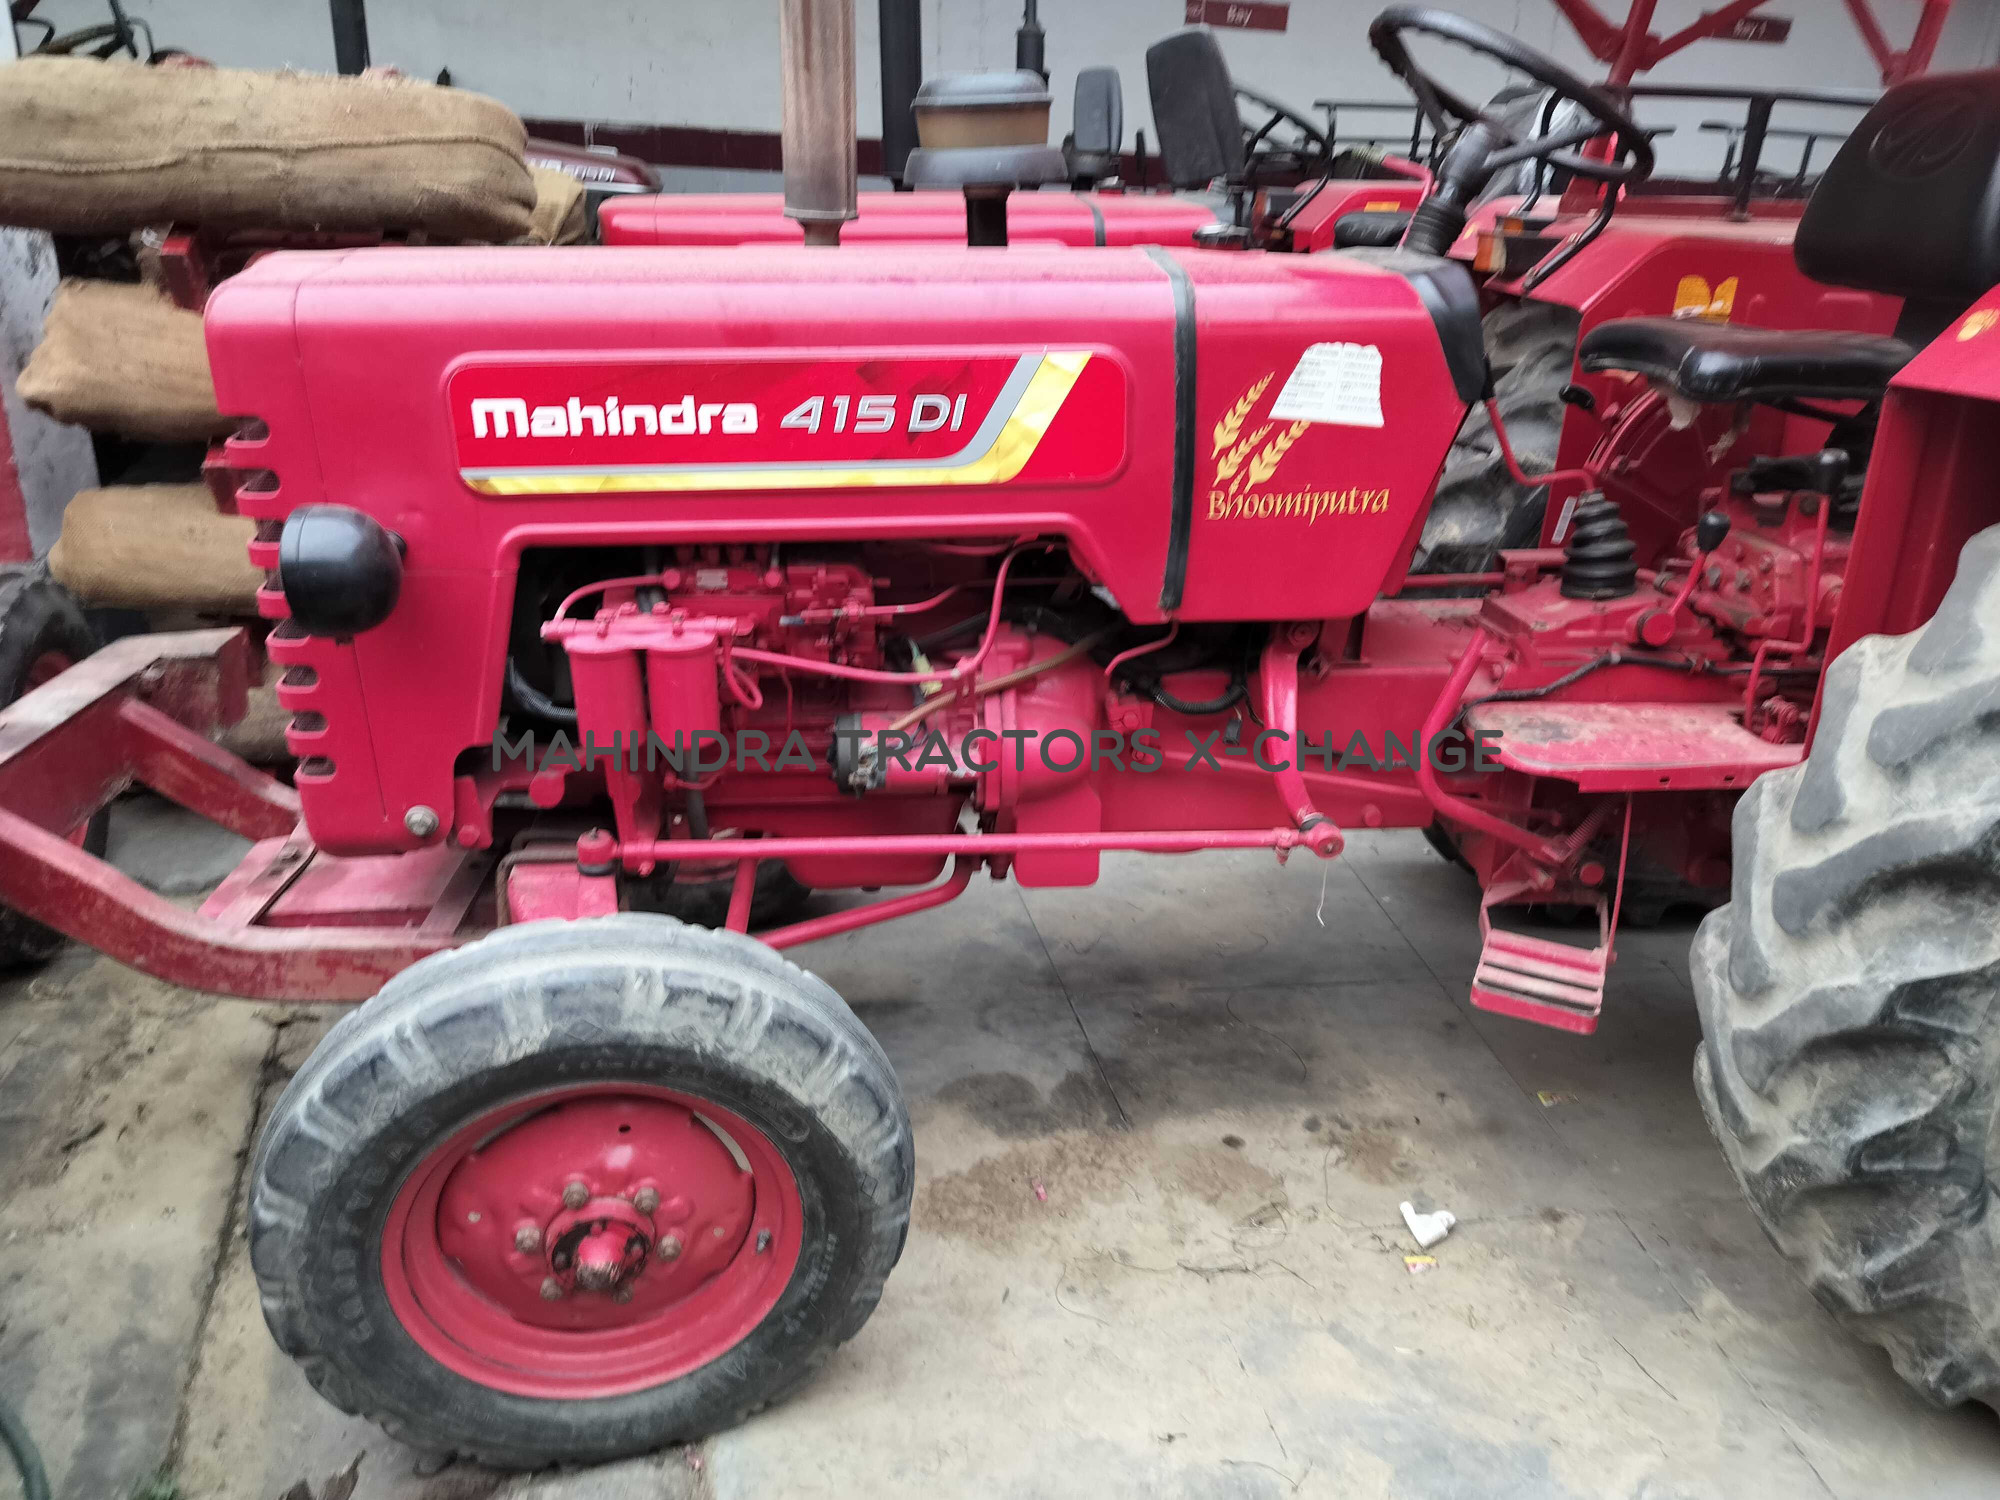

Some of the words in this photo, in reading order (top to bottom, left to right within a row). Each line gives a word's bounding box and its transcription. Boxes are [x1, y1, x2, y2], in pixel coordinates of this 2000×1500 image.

[470, 395, 759, 438] Mahindra
[780, 394, 898, 434] 415
[907, 393, 969, 432] DI
[1205, 483, 1391, 527] Bhoomiputra
